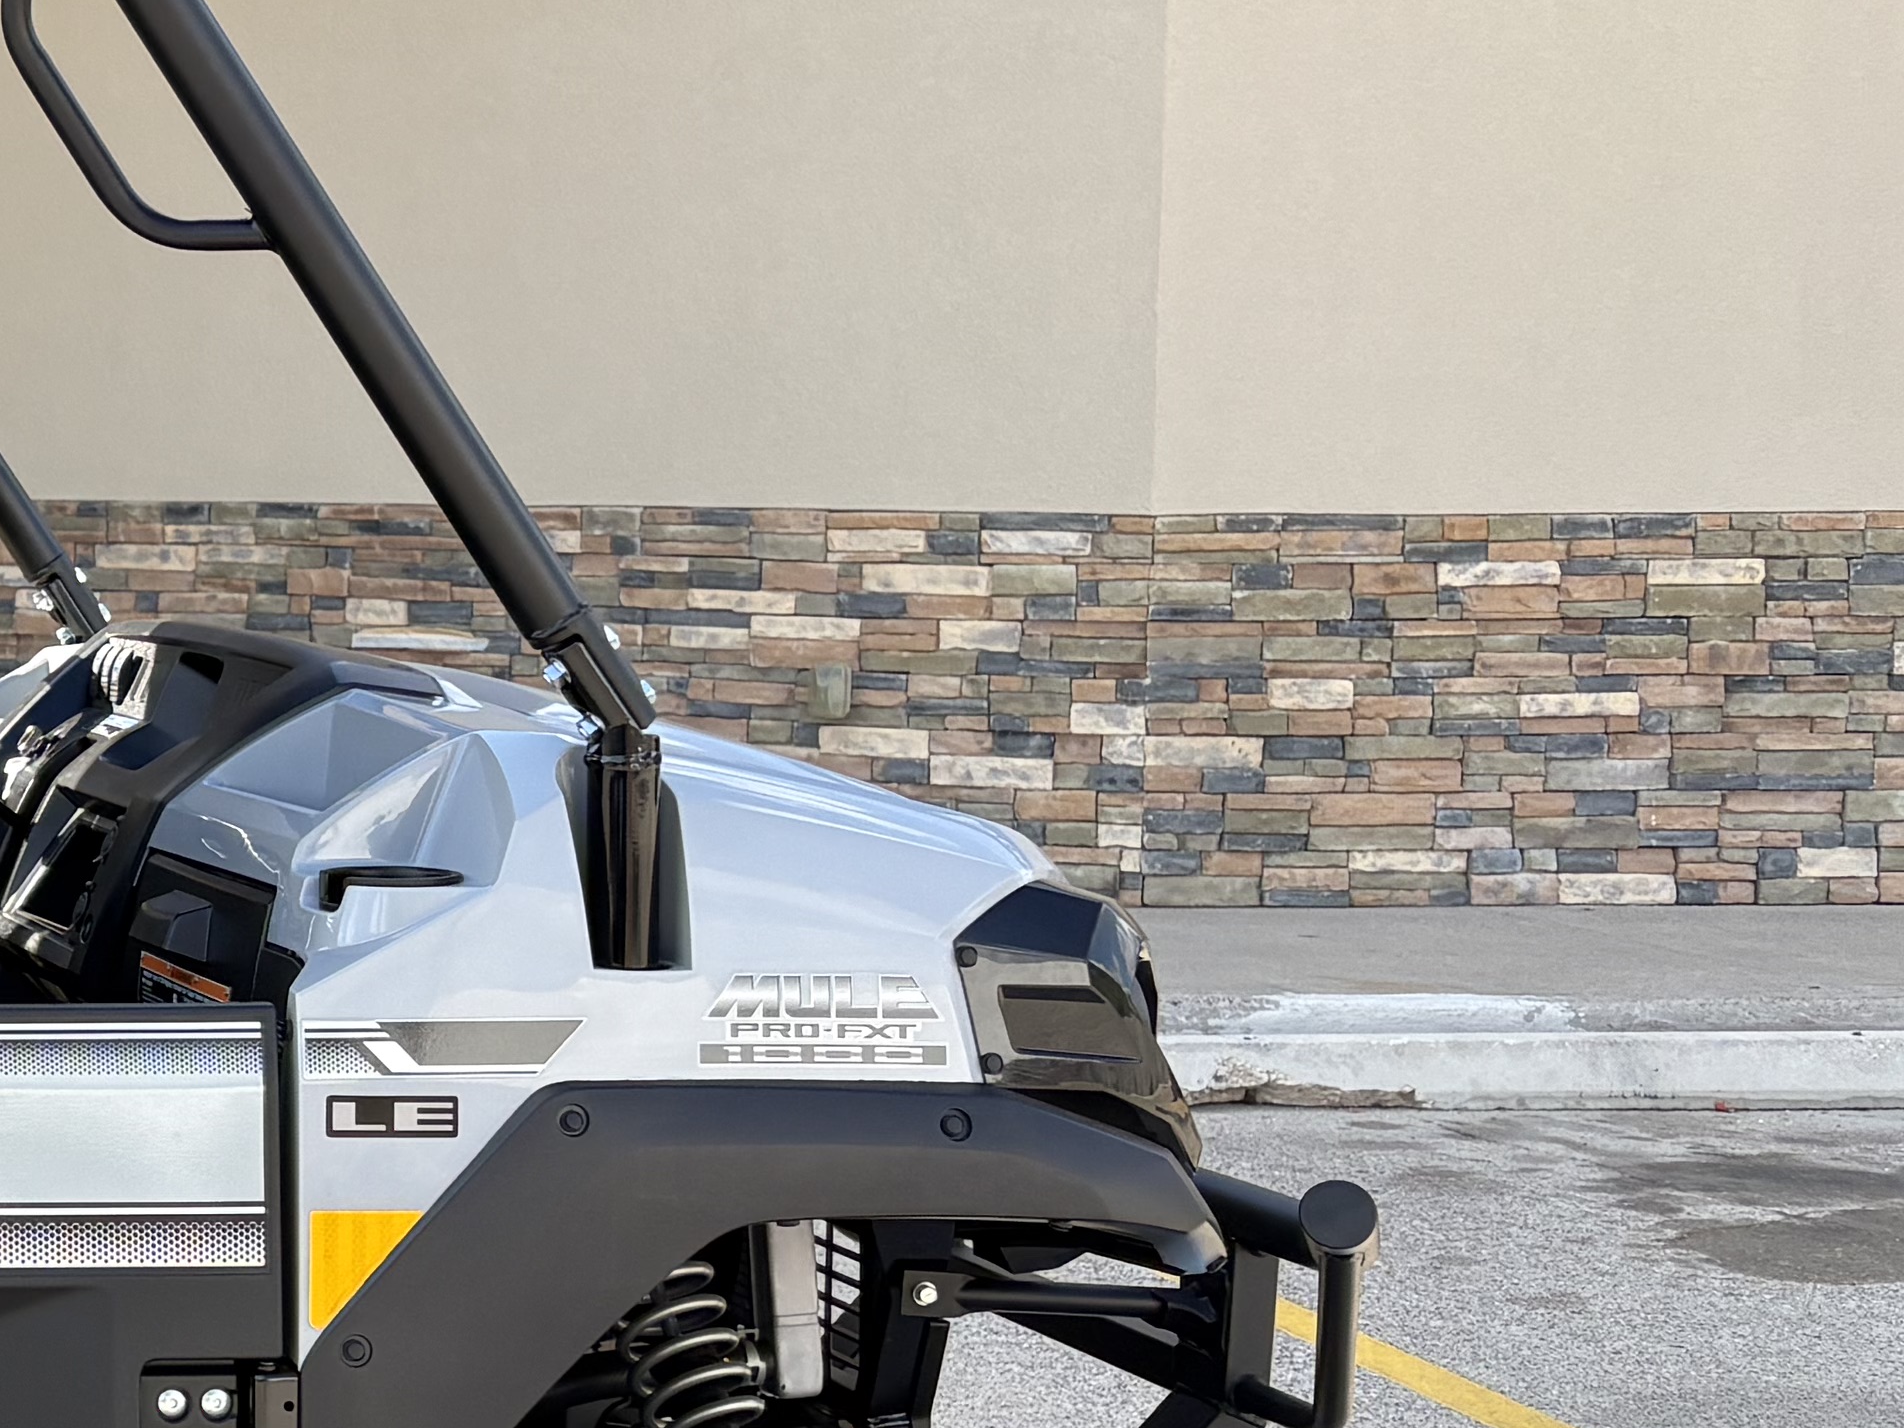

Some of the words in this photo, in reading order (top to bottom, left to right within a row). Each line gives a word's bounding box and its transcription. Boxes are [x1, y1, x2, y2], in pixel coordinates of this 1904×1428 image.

[705, 973, 942, 1020] MULE
[729, 1022, 919, 1040] PRO-FXT
[723, 1045, 924, 1064] 1000
[332, 1101, 454, 1131] LE
